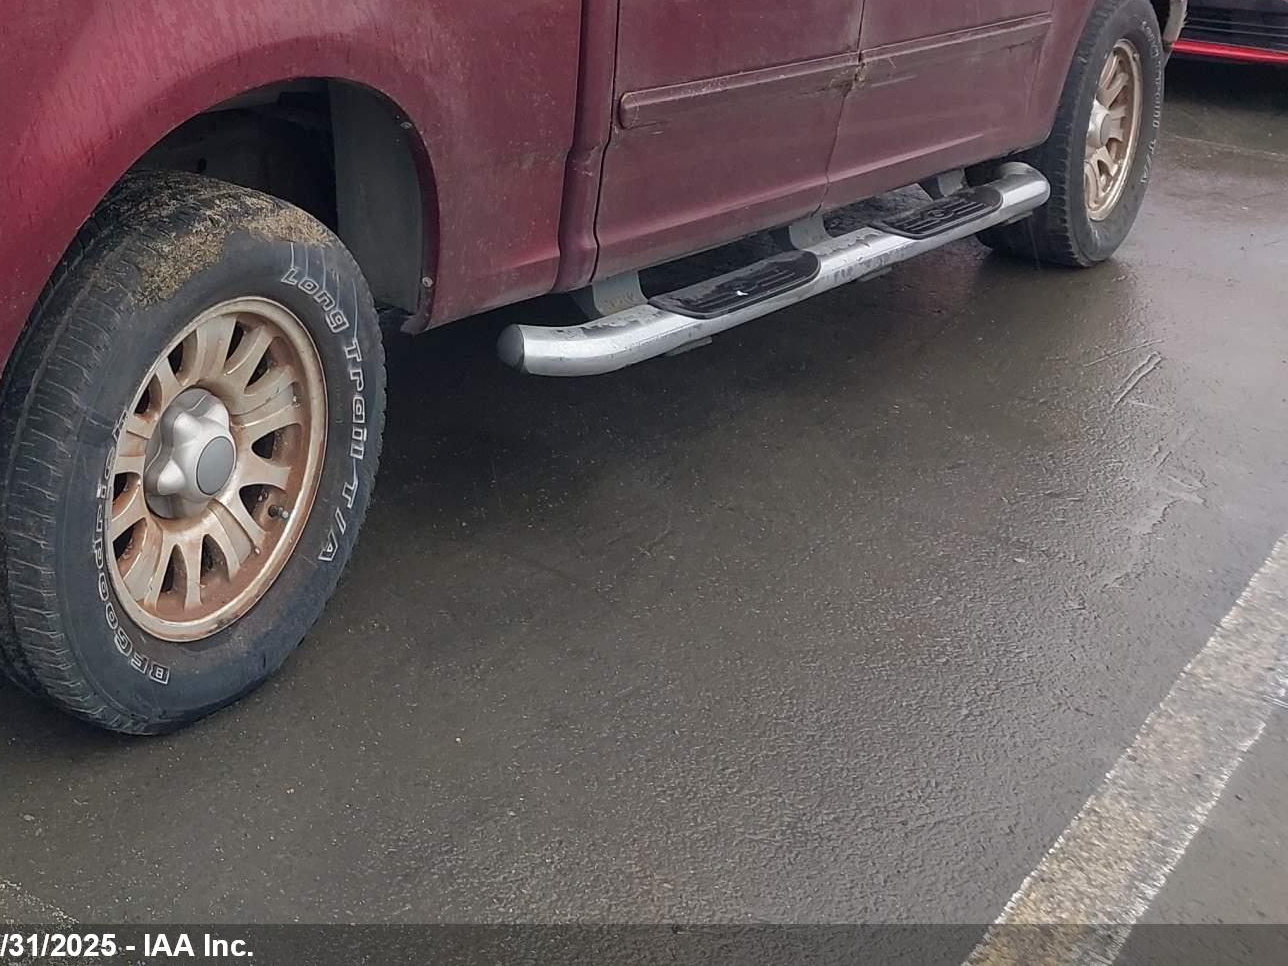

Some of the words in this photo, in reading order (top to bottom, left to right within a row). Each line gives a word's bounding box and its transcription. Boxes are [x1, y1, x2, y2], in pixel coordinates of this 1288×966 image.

[281, 267, 350, 334] Long
[344, 337, 368, 461] Trail
[318, 476, 359, 562] T/A
